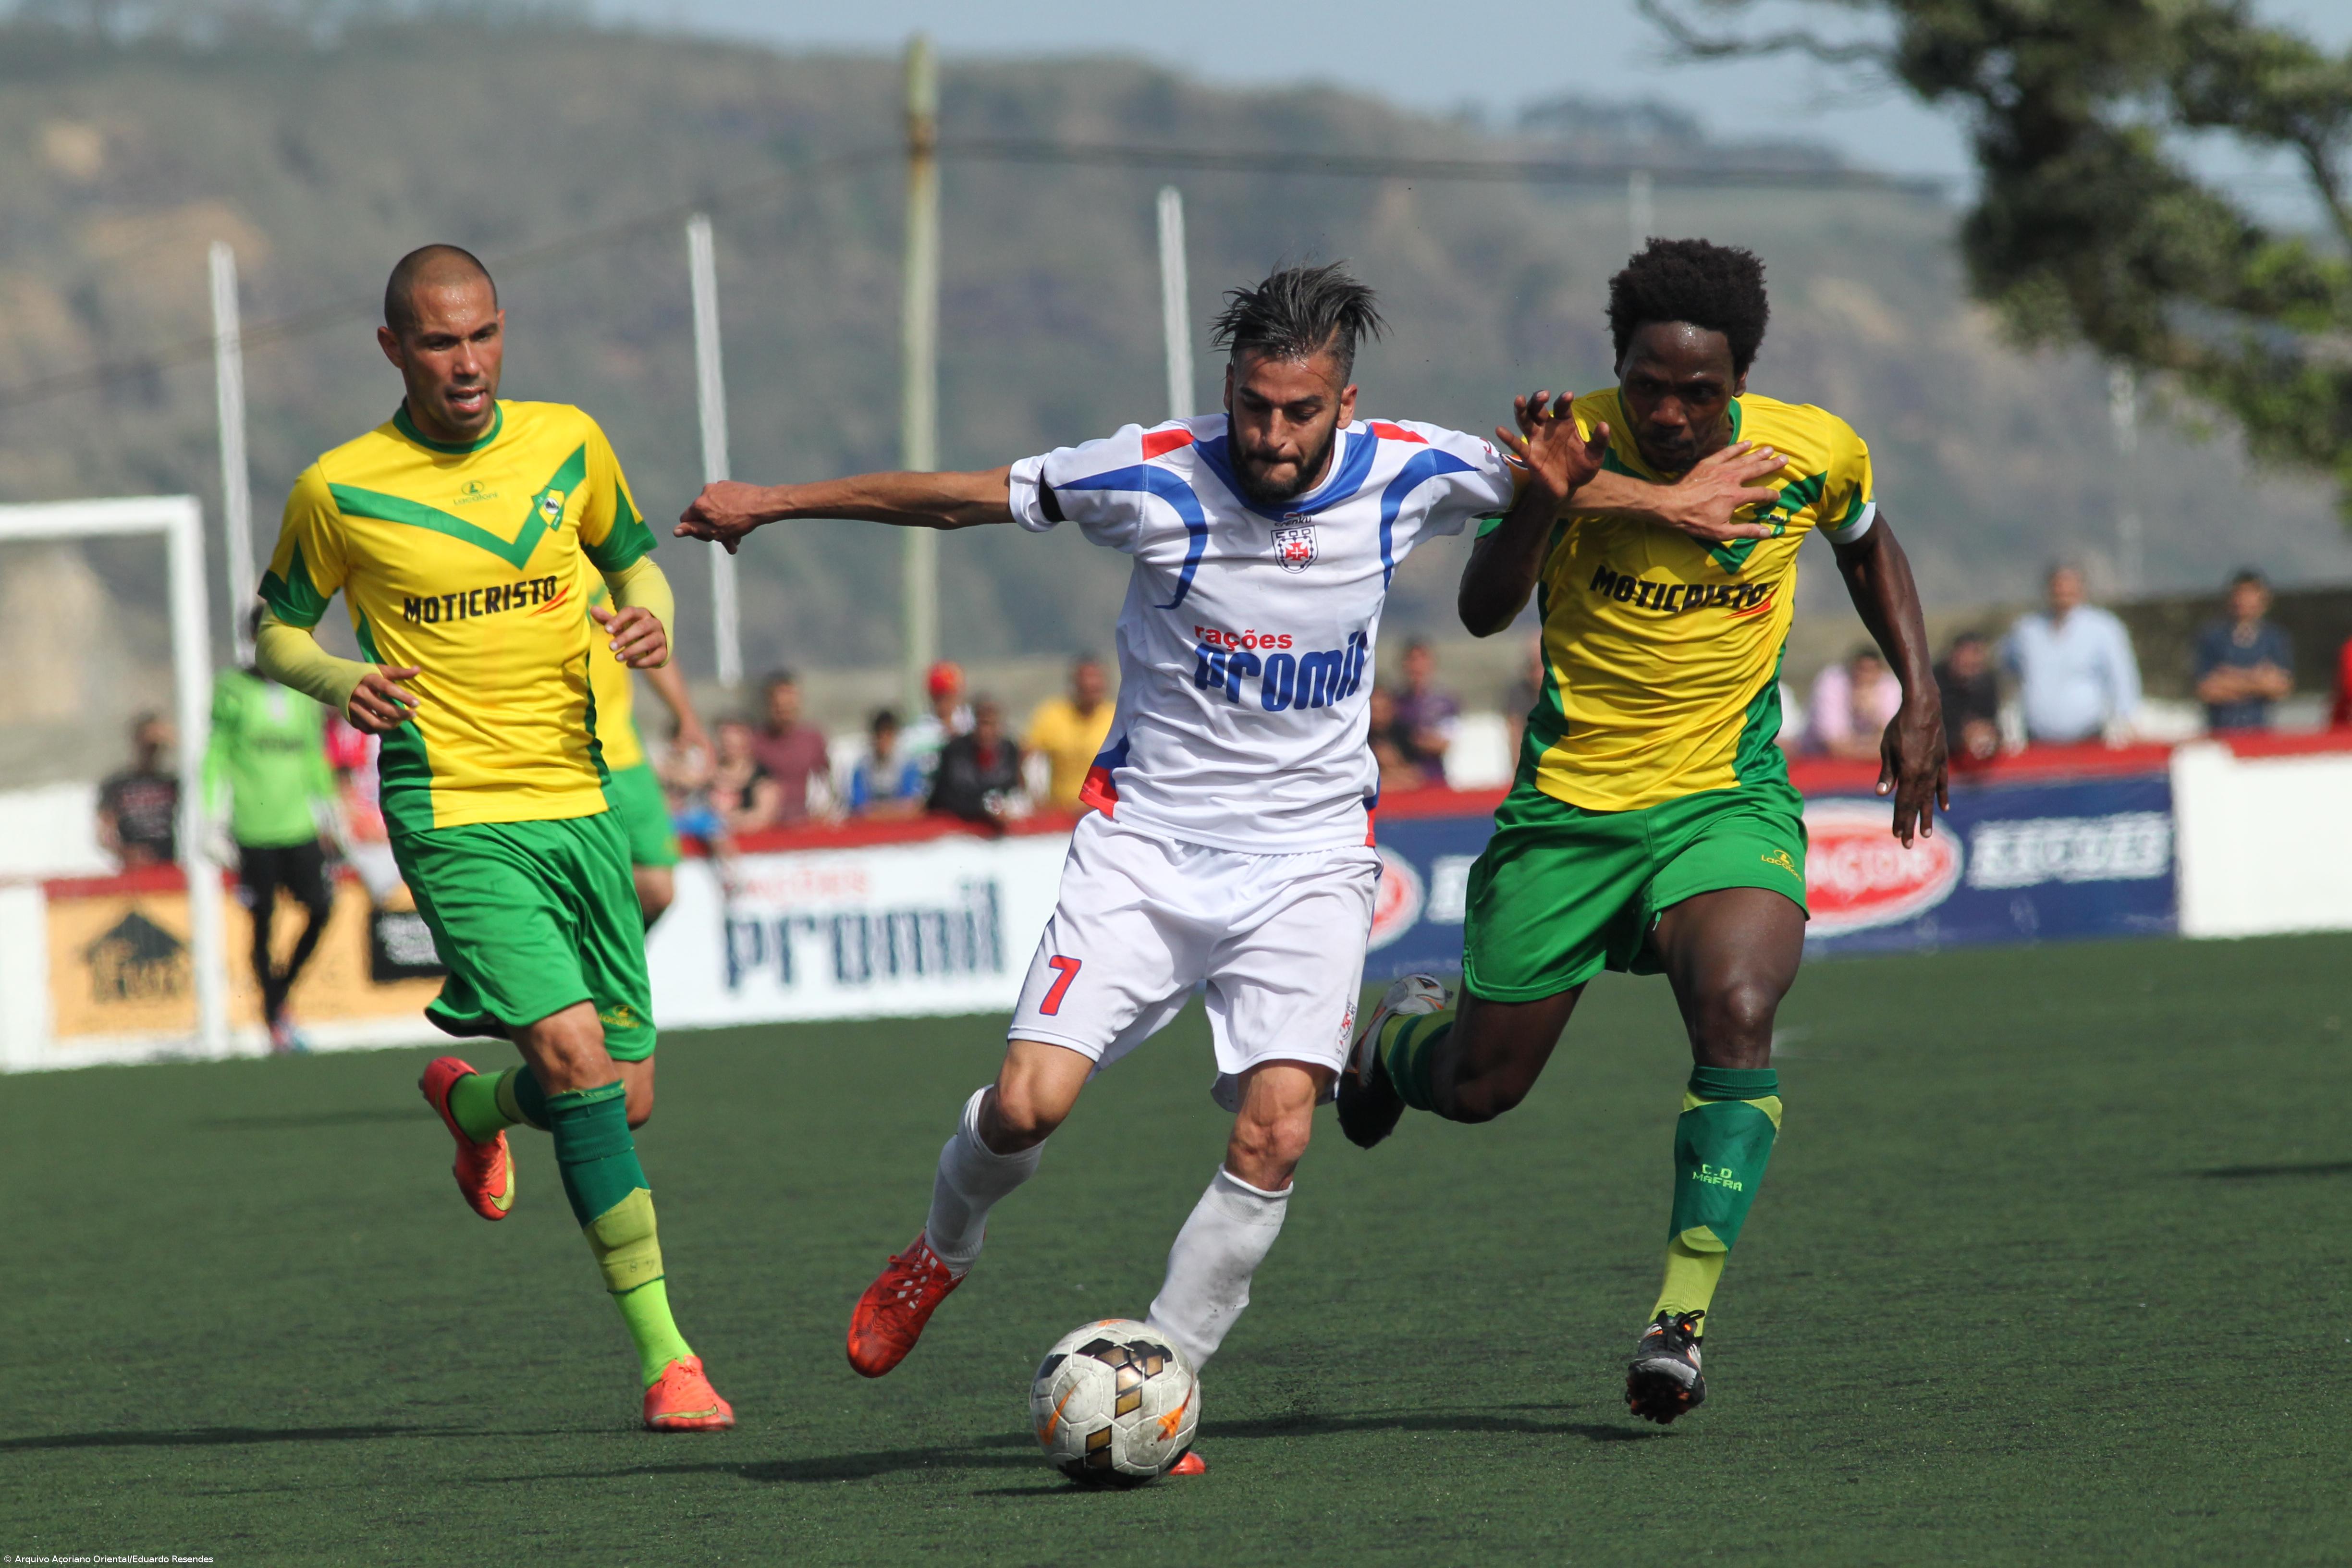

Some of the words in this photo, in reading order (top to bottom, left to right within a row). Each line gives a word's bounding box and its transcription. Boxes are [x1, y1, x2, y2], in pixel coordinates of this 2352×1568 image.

[403, 575, 557, 625] MOTICRISTO
[1194, 625, 1293, 651] rações
[1039, 955, 1082, 1016] 7
[1692, 1171, 1743, 1192] MAFRA
